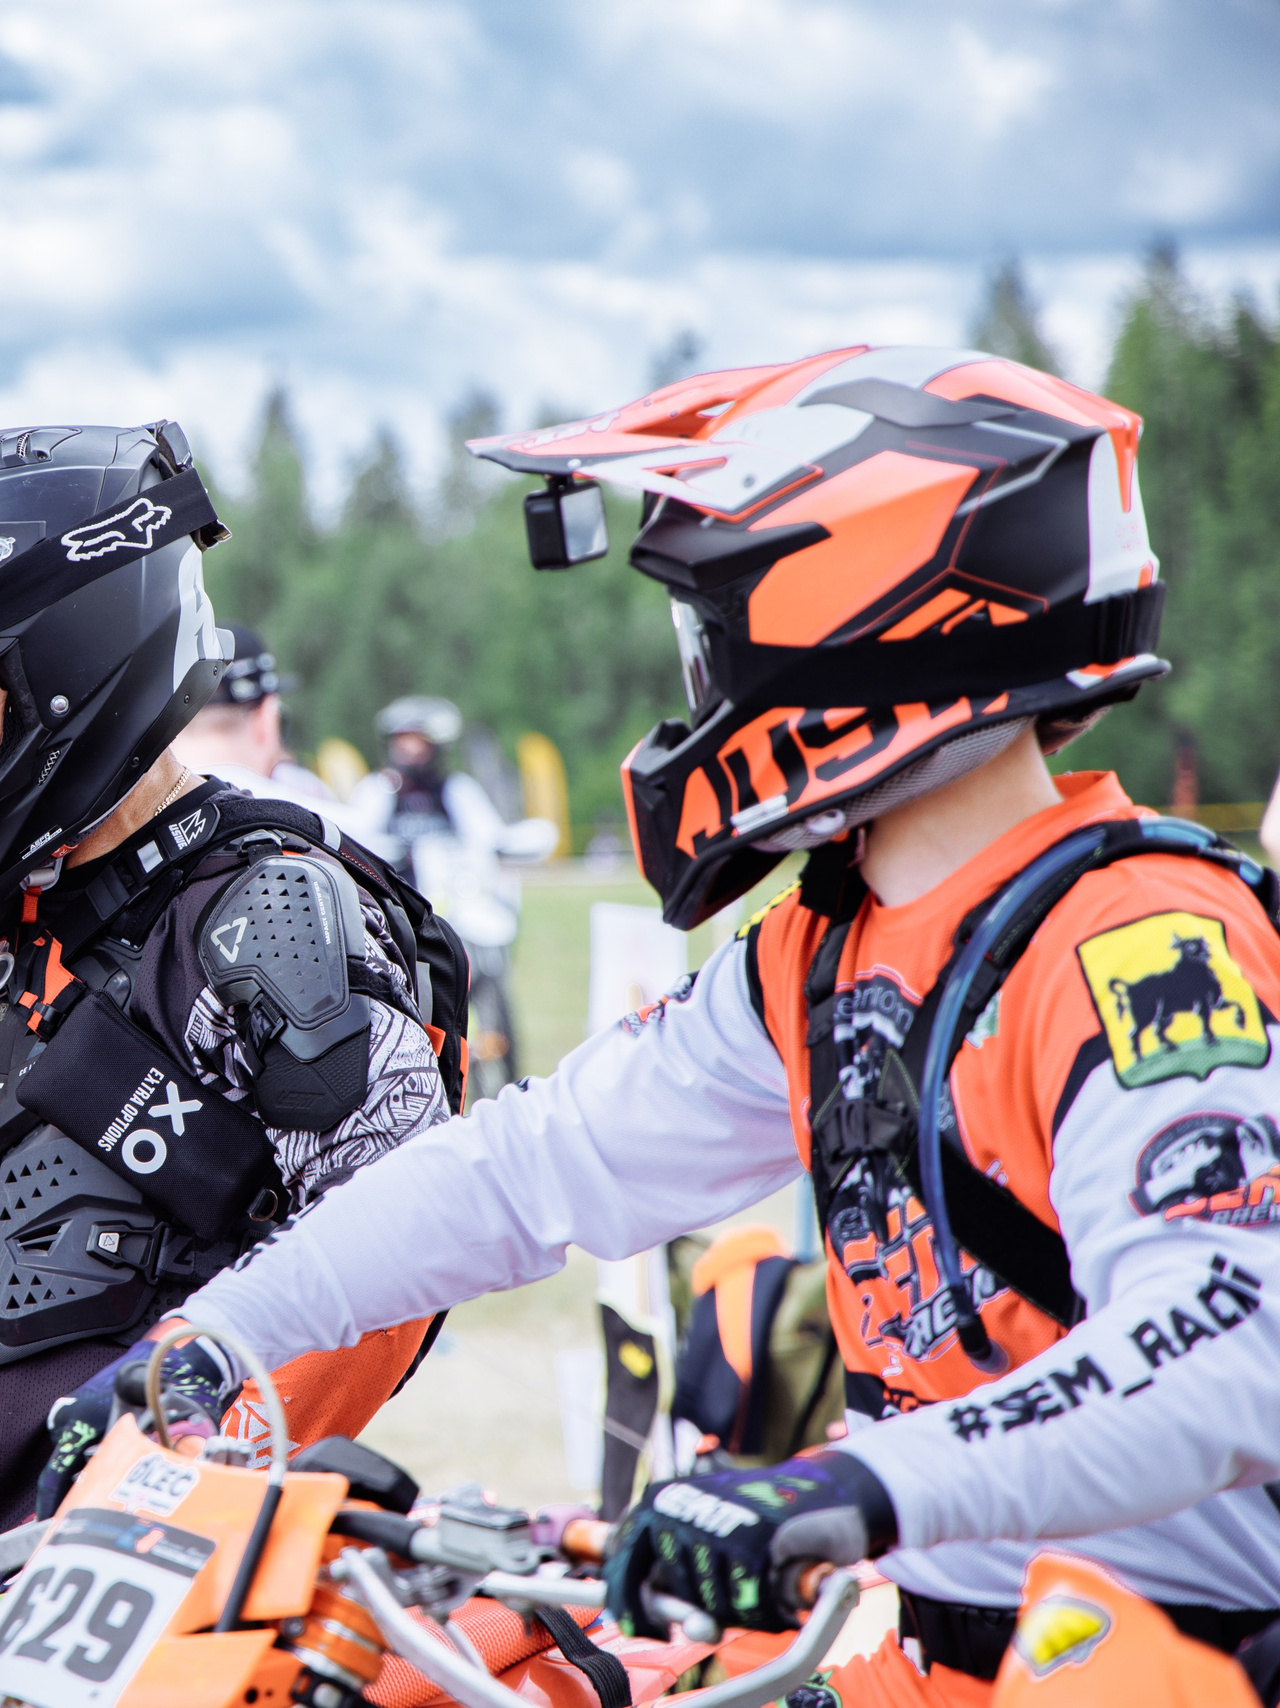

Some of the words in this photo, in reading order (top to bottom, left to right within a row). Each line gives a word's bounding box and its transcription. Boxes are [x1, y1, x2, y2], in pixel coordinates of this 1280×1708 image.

[168, 823, 188, 851] USWE
[129, 1067, 165, 1107] EXTRA
[97, 1103, 139, 1152] OPTIONS
